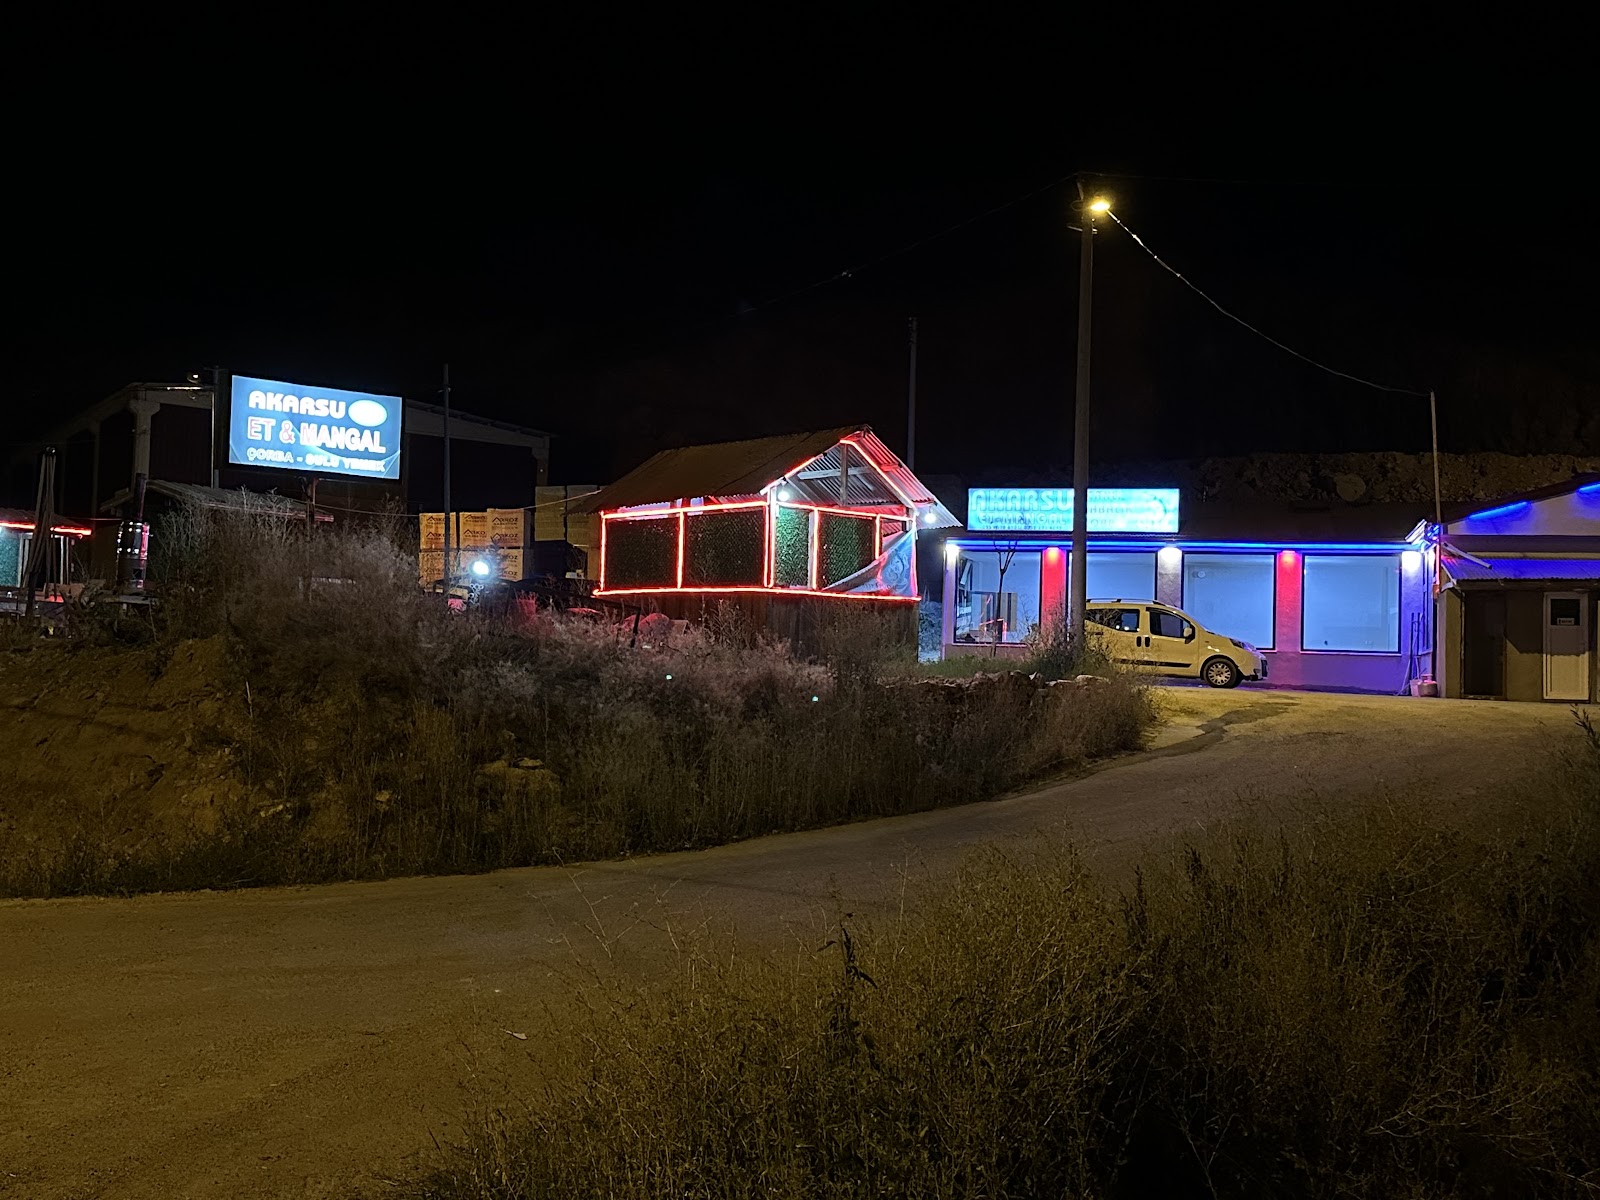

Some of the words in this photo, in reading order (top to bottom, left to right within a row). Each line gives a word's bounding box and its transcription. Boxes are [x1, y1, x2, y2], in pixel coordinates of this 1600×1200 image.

[248, 390, 347, 419] AKARSU
[247, 415, 277, 442] ET
[279, 419, 296, 444] &
[299, 422, 387, 454] MANGAL
[246, 446, 295, 464] ÇORBA
[971, 488, 1073, 512] AKARSU
